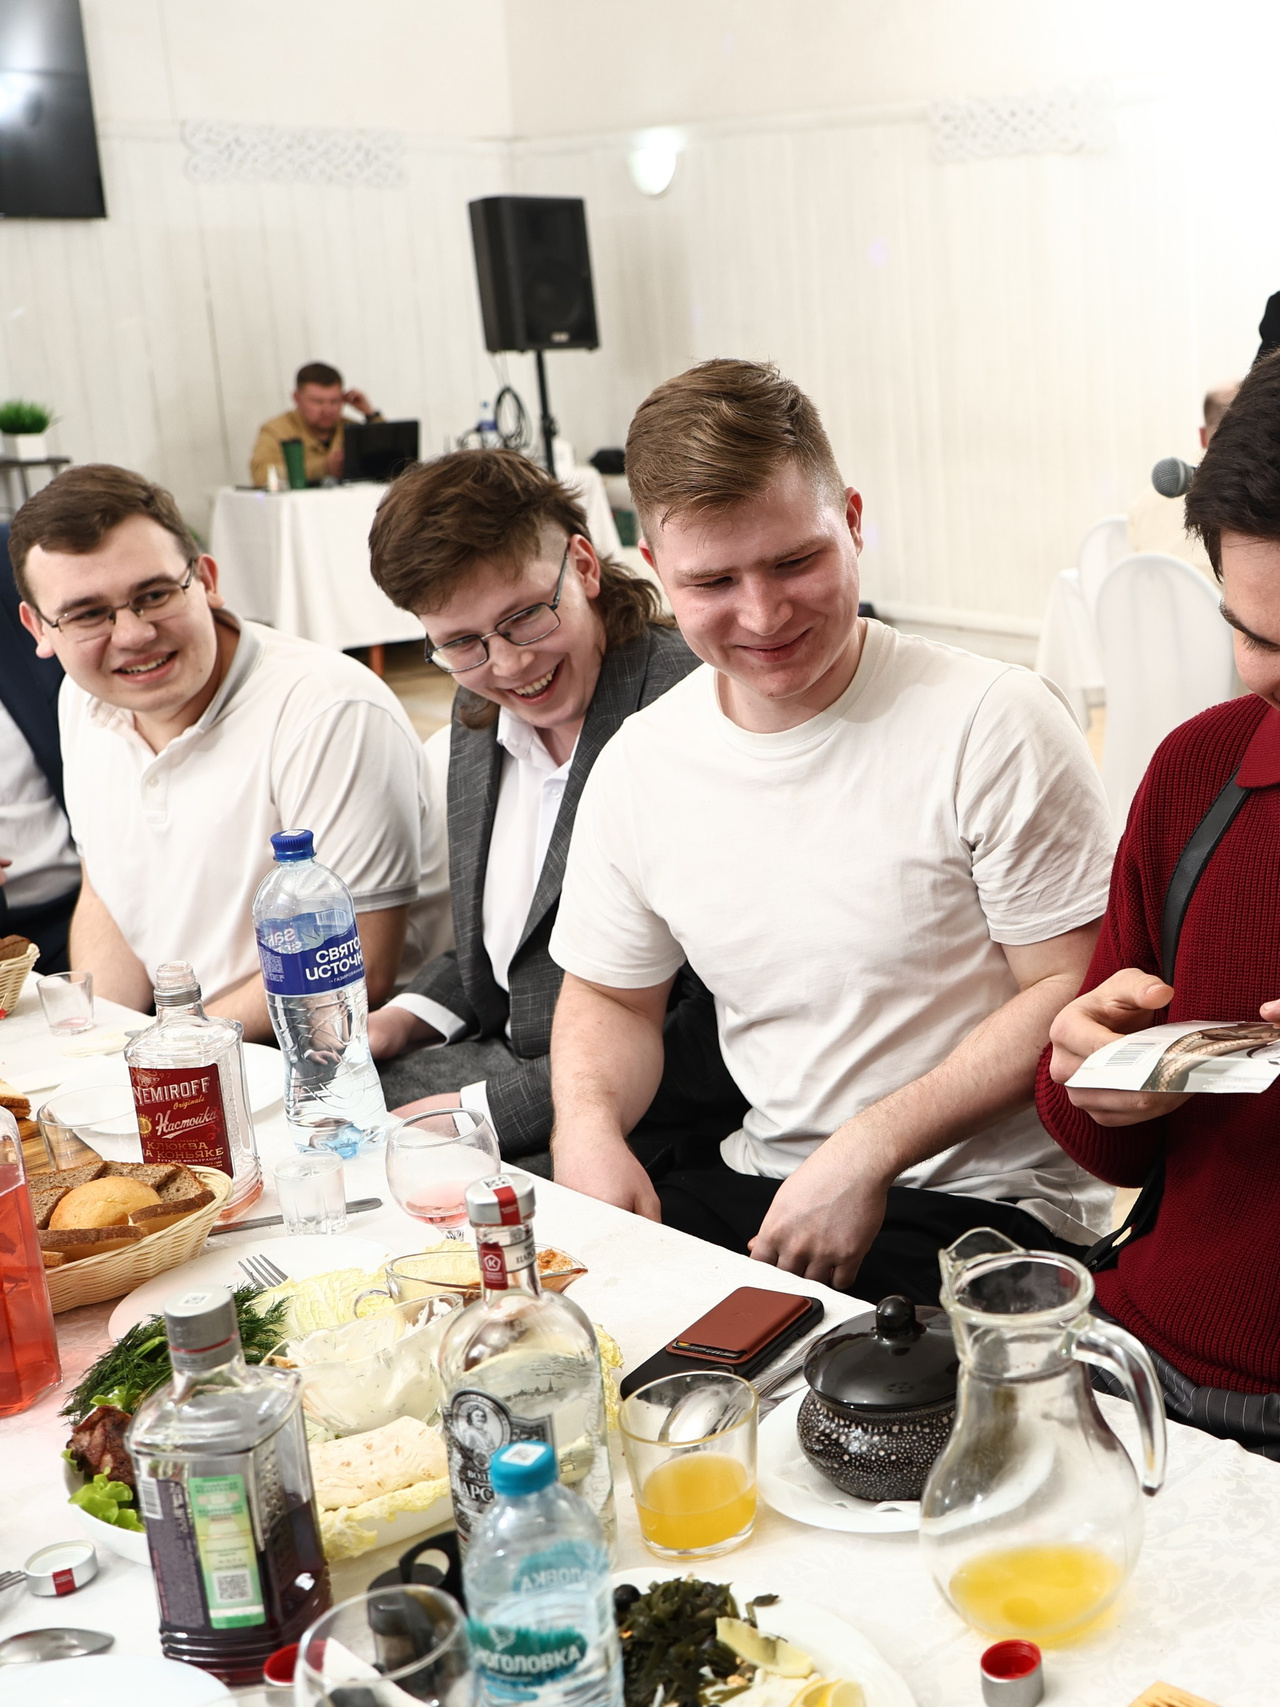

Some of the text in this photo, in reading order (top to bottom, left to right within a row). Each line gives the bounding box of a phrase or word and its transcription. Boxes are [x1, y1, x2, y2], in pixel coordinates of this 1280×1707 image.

[133, 1076, 211, 1106] NEMIROFF
[147, 1141, 208, 1151] КЛЮКВА
[157, 1147, 224, 1160] КОНЬЯКЕ
